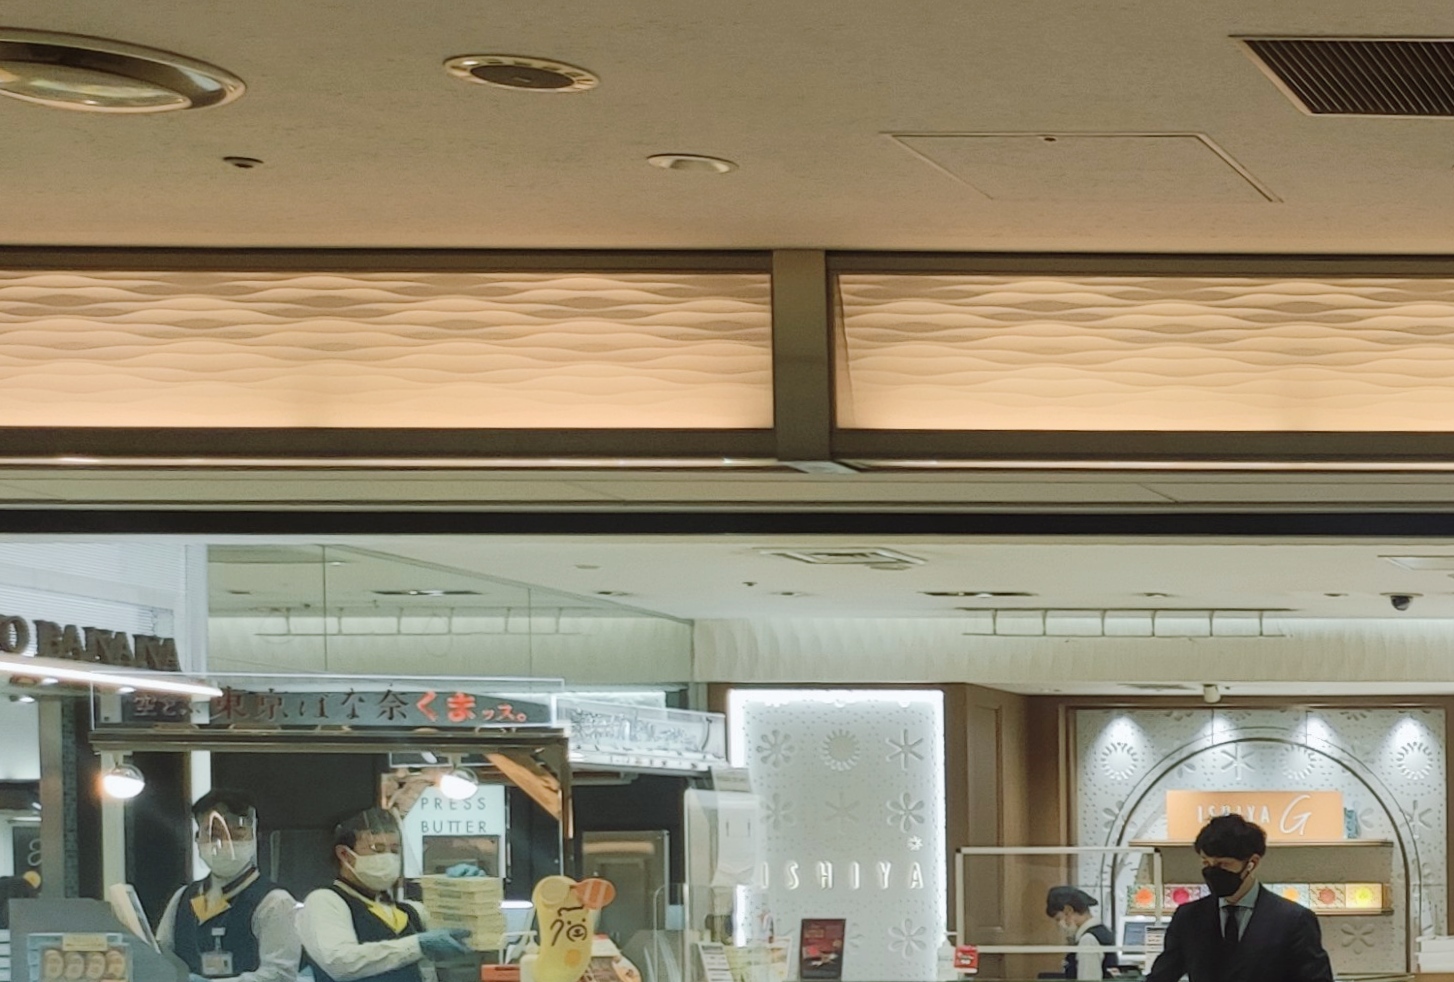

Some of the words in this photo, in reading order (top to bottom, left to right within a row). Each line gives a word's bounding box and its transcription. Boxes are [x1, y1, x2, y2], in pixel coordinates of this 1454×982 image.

[420, 797, 487, 811] PRESS
[1279, 794, 1313, 836] G
[420, 820, 488, 834] BUTTER
[760, 861, 924, 890] ISHIYA
